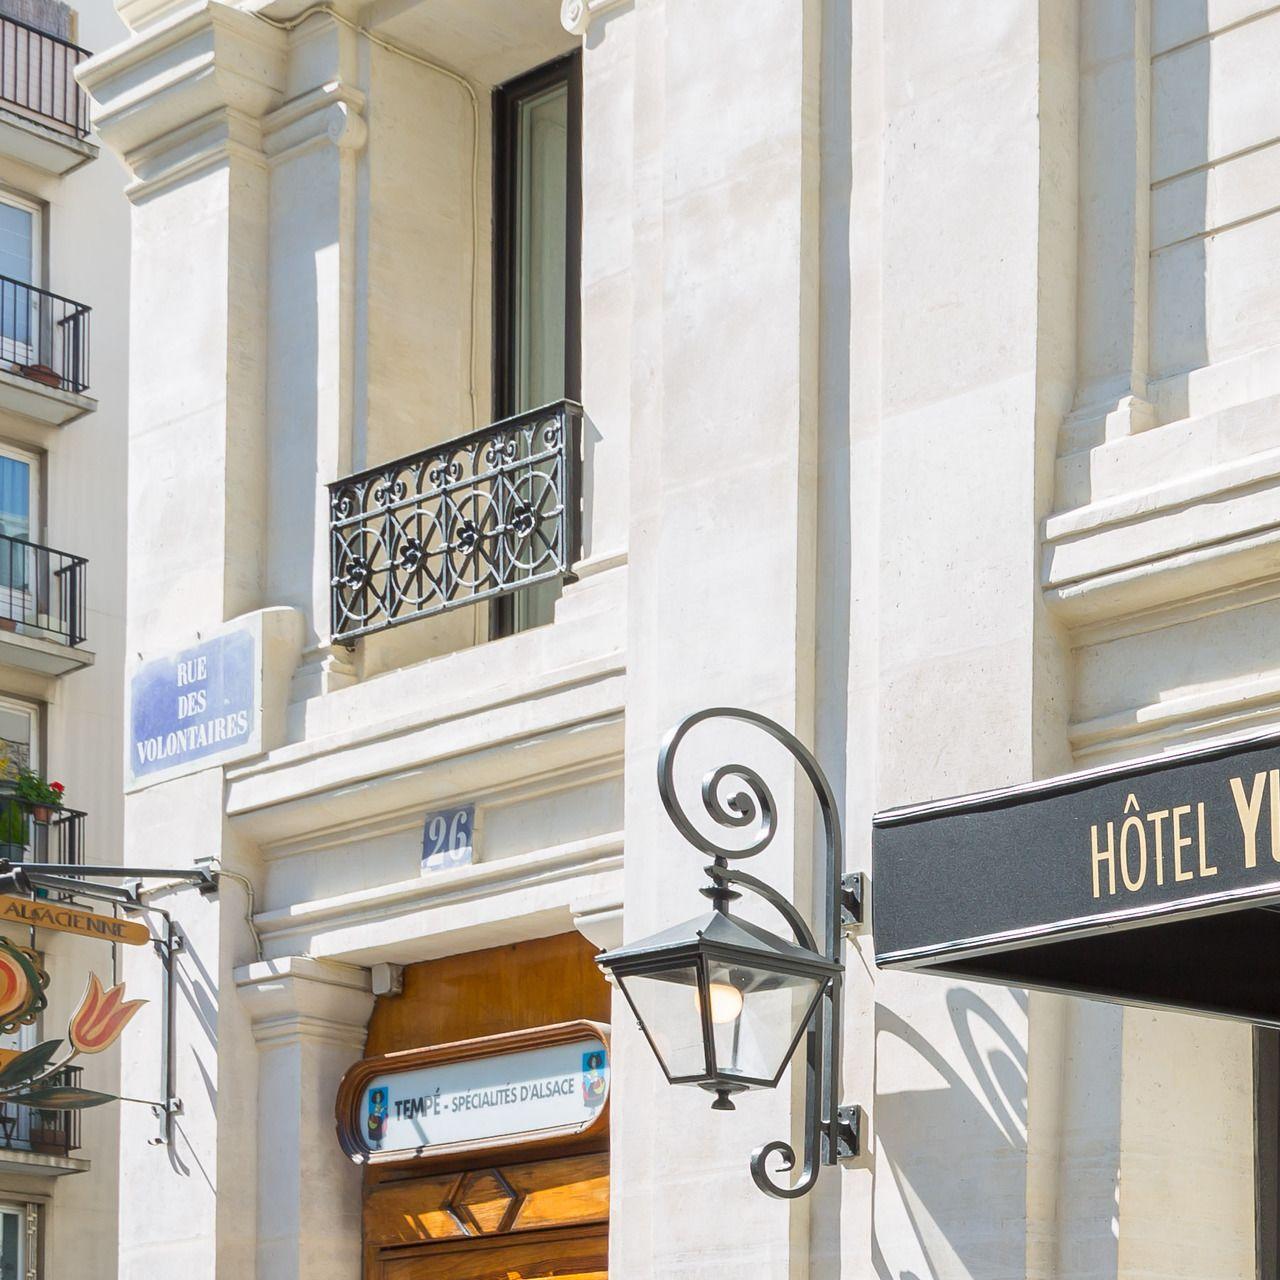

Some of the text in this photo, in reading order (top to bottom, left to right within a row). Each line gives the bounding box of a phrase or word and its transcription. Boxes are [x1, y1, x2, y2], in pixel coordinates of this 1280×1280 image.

[177, 656, 208, 687] RUE
[178, 690, 207, 720] DES
[136, 709, 248, 764] VOLONTAIRES
[424, 810, 468, 866] 26
[1090, 793, 1218, 899] HÔTEL
[4, 901, 128, 939] ALSACIENNE
[394, 1087, 441, 1121] TEMPÉ
[452, 1082, 517, 1113] SPÉCIALITÉS
[520, 1078, 575, 1102] D'ALSACE
